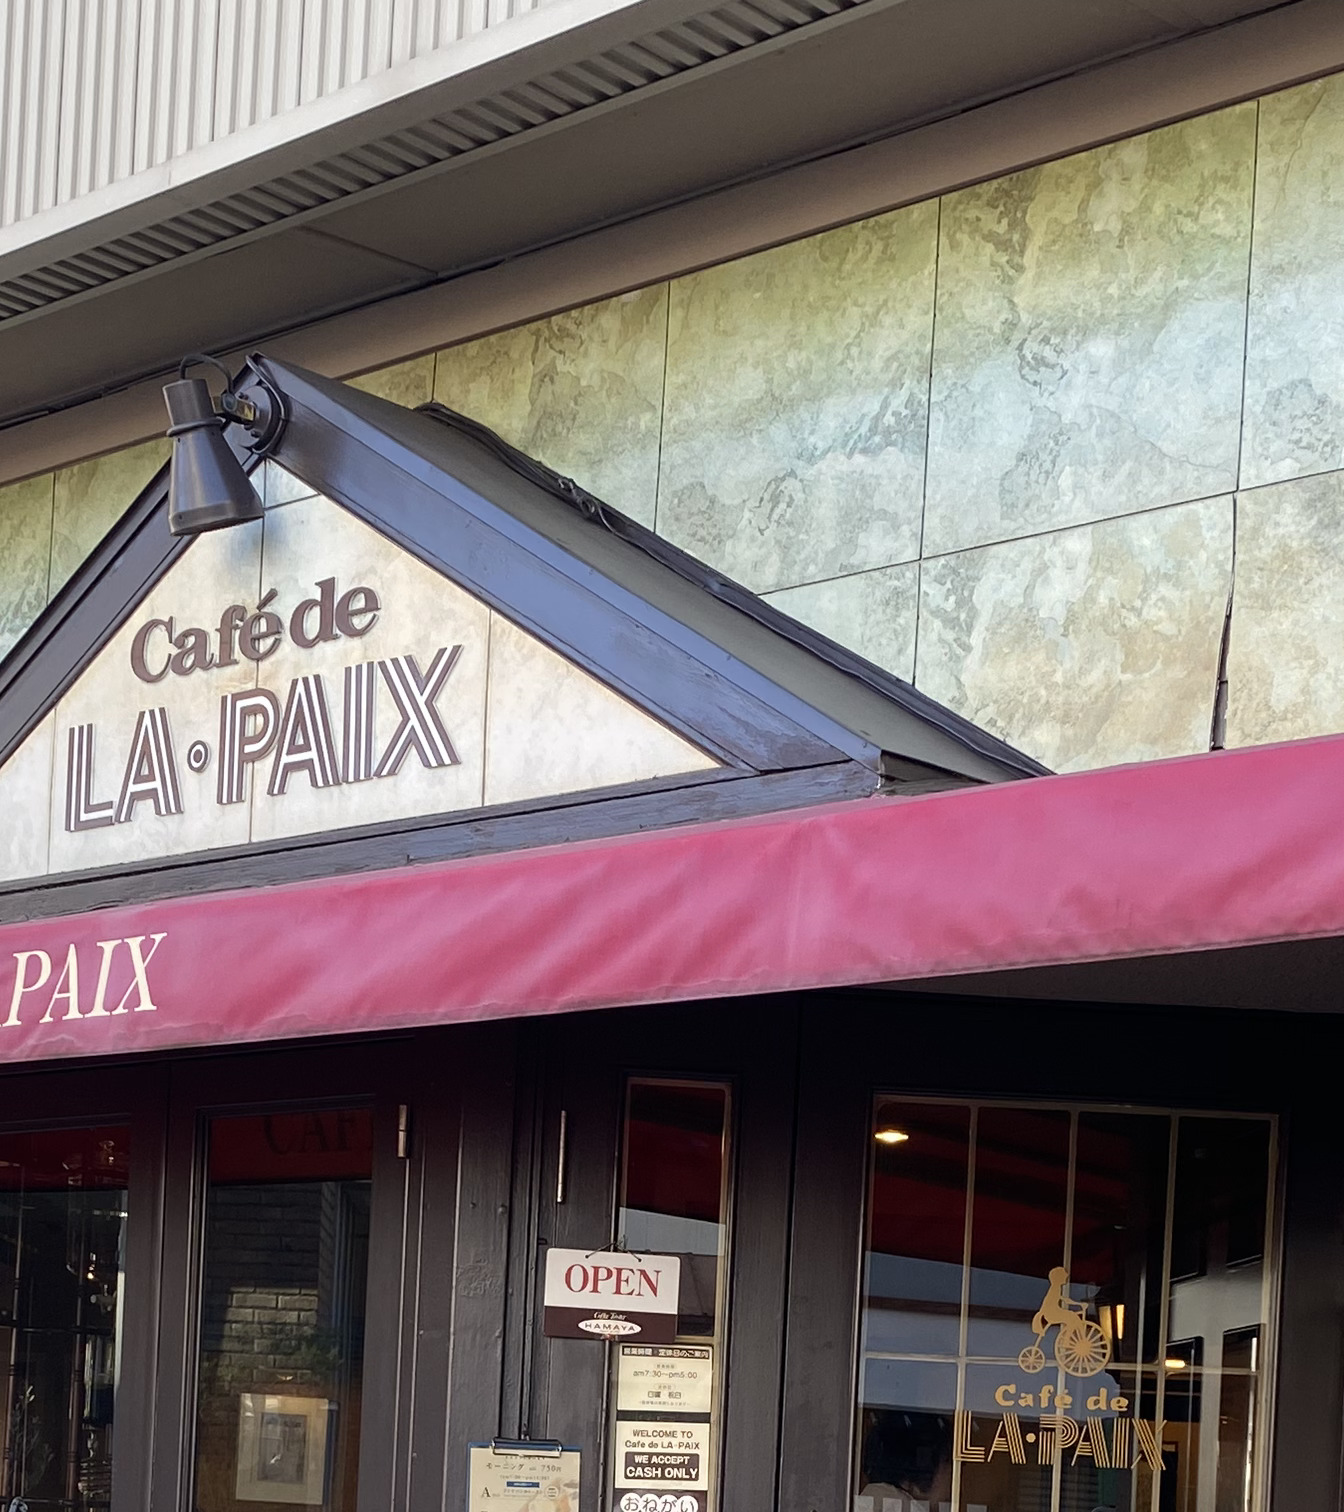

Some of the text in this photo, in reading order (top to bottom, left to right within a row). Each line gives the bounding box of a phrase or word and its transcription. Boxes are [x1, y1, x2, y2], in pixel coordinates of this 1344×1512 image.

[130, 576, 382, 684] Café de
[564, 1263, 662, 1298] OPEN
[584, 1322, 635, 1332] HAMAYA
[1086, 1388, 1129, 1412] de
[633, 1429, 693, 1439] WELCOME TO
[634, 1455, 690, 1465] WE ACCEPT
[626, 1467, 698, 1479] CASH ONLY
[481, 1487, 491, 1498] A
